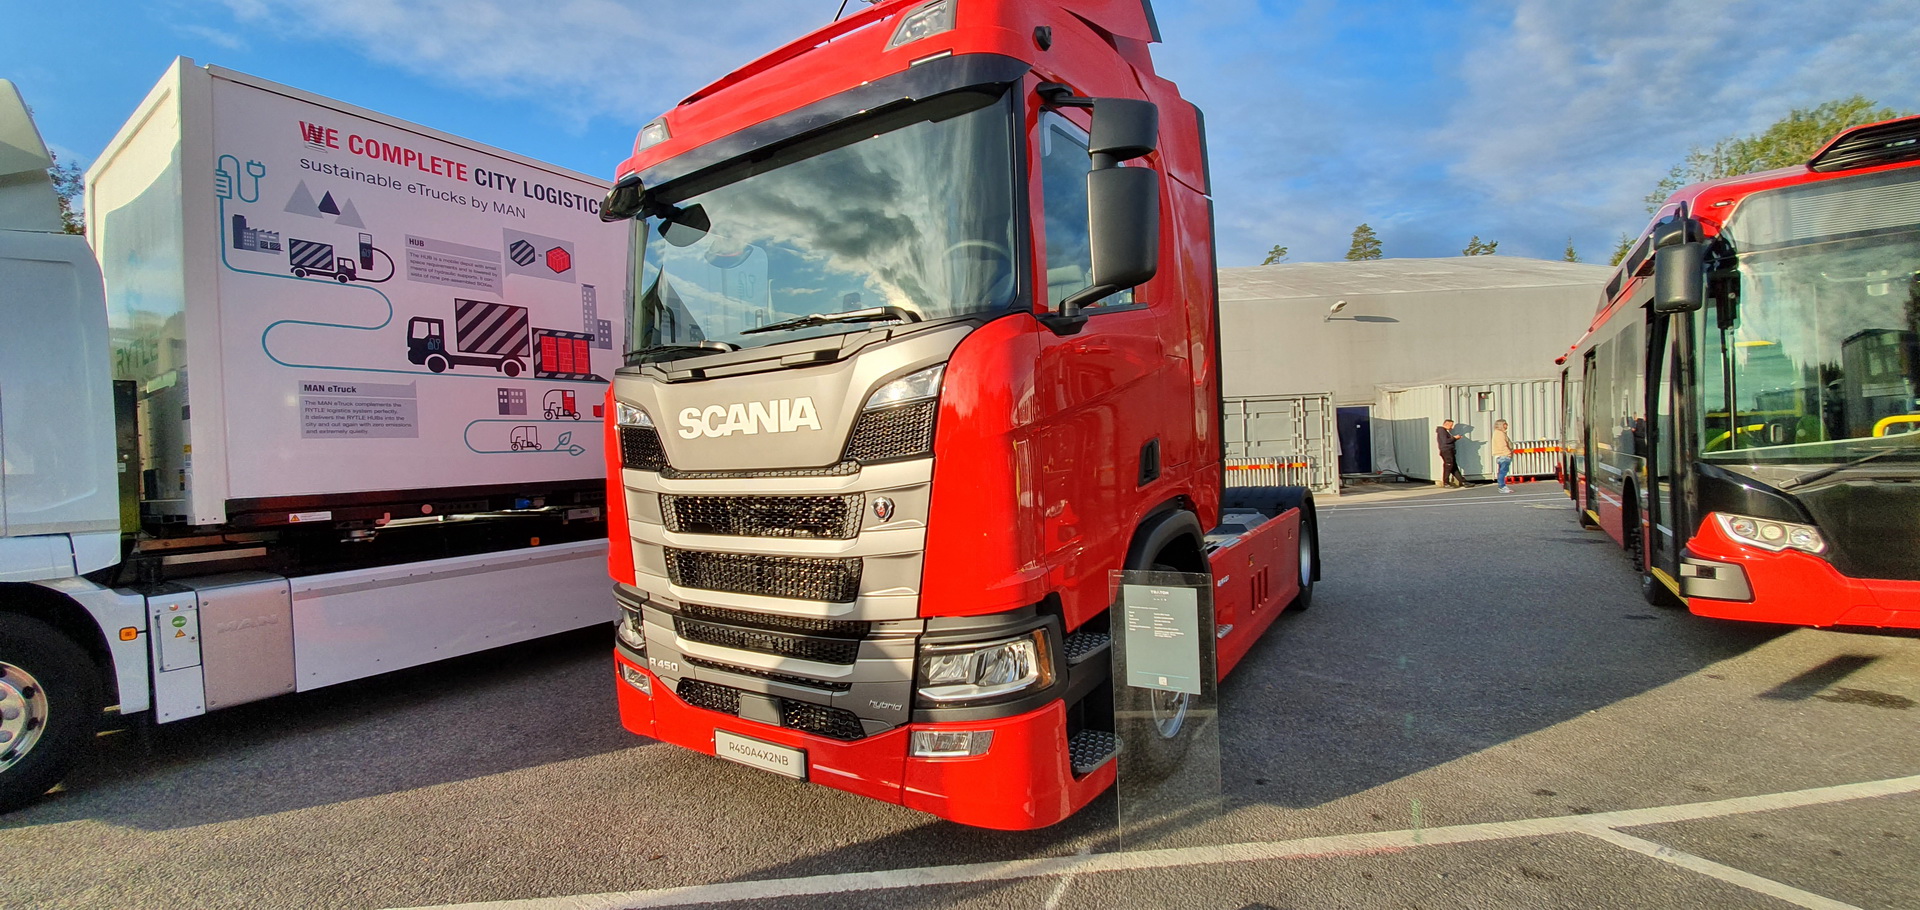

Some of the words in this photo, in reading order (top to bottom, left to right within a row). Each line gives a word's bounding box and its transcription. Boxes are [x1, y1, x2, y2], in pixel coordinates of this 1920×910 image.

[299, 121, 339, 149] WE
[349, 134, 467, 181] COMPLETE
[475, 168, 516, 193] CITY
[524, 181, 603, 214] LOGISTIC
[300, 158, 401, 190] sustainable
[408, 183, 466, 205] eTrucks
[472, 196, 488, 212] by
[494, 201, 525, 218] MAN
[409, 238, 424, 246] HUB
[426, 262, 457, 270] requirements
[328, 385, 356, 393] eTruck
[678, 396, 822, 440] SCANIA
[650, 657, 656, 666] R
[658, 660, 679, 672] 450
[869, 700, 902, 711] hybrid
[729, 742, 789, 766] R450A4X2NB
